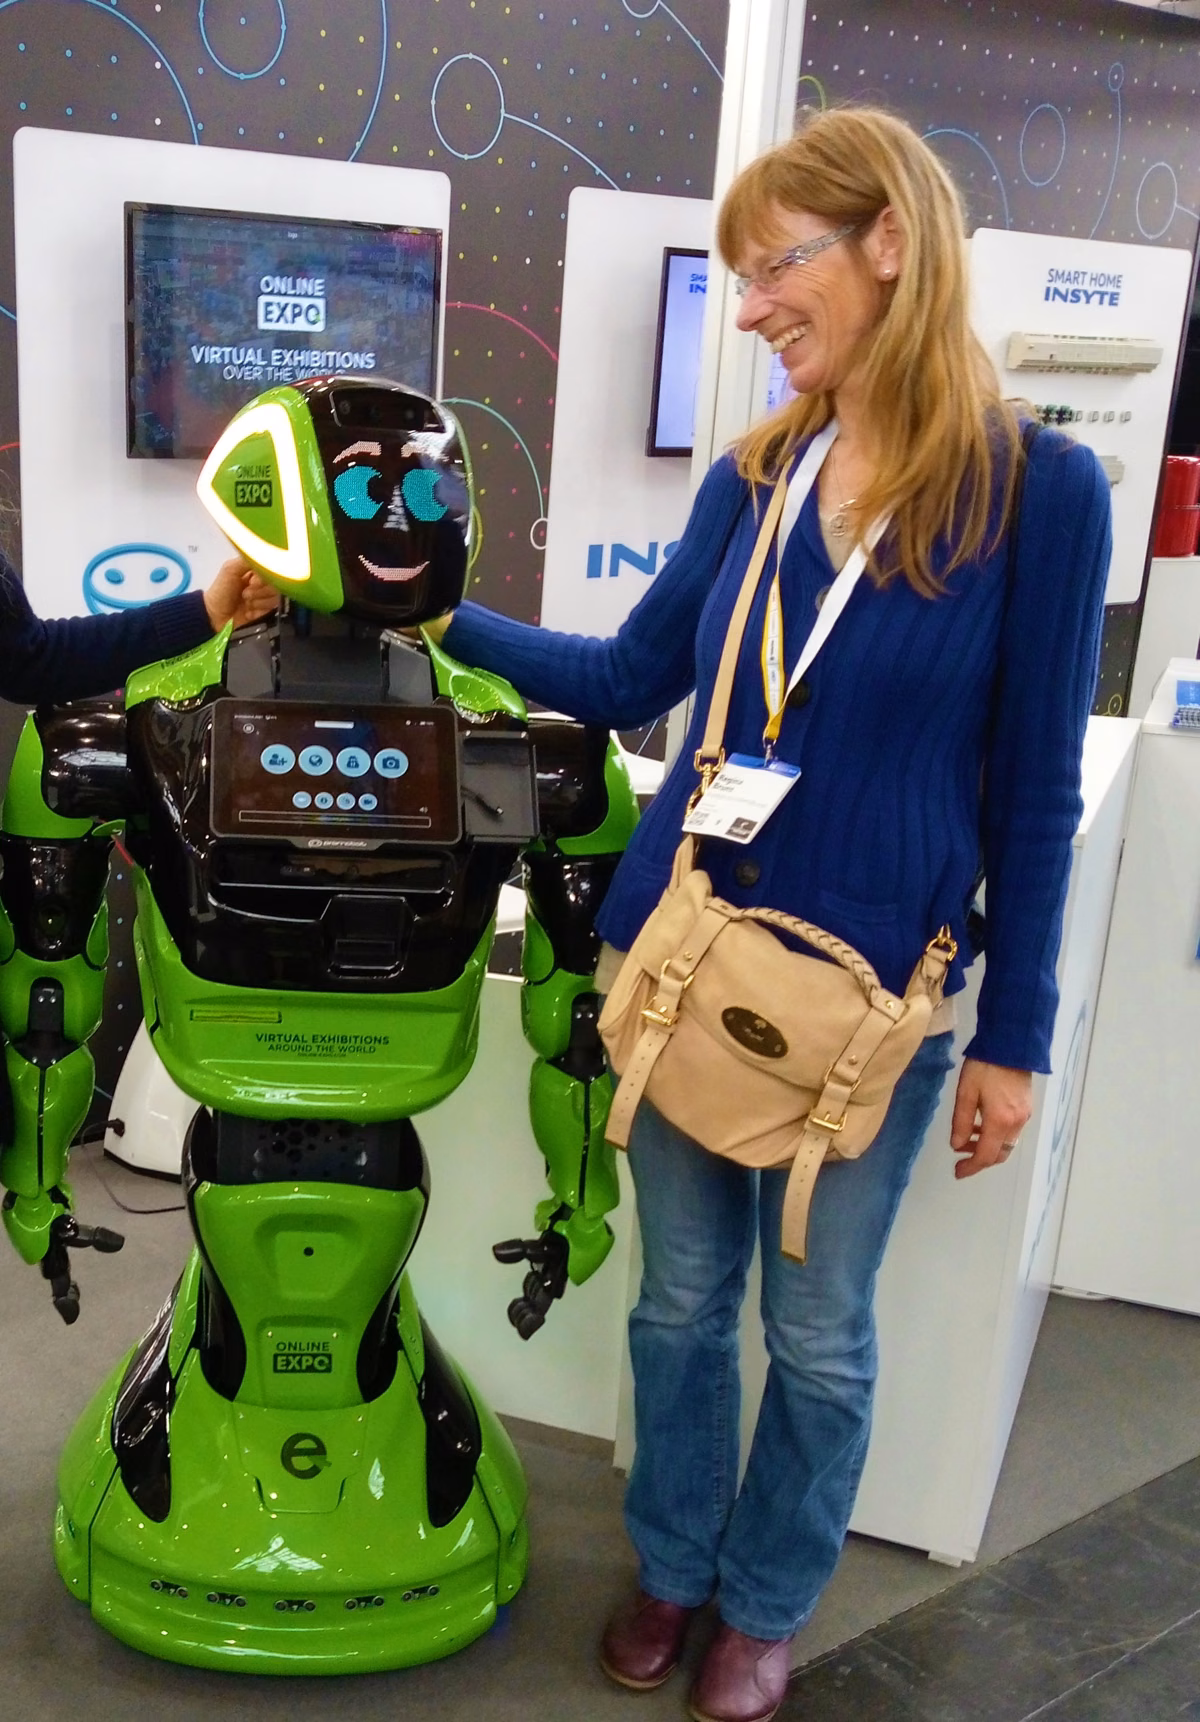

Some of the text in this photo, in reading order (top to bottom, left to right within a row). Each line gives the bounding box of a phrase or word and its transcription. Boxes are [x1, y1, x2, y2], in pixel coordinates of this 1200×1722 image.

[260, 275, 325, 297] ONLINE
[1047, 268, 1123, 289] SMART HOME
[1044, 286, 1120, 307] INSYTE
[262, 300, 322, 326] EXPO
[190, 344, 376, 370] VIRTUAL EXHIBITIONS
[222, 365, 263, 381] OVER
[265, 366, 294, 382] THE
[236, 464, 272, 479] ONLINE
[236, 483, 271, 504] EXPO
[256, 1033, 390, 1046] VIRTUAL EXHIBITIONS
[268, 1043, 377, 1054] AROUND THE WORLD
[276, 1341, 330, 1352] ONLINE
[276, 1354, 330, 1371] EXPO
